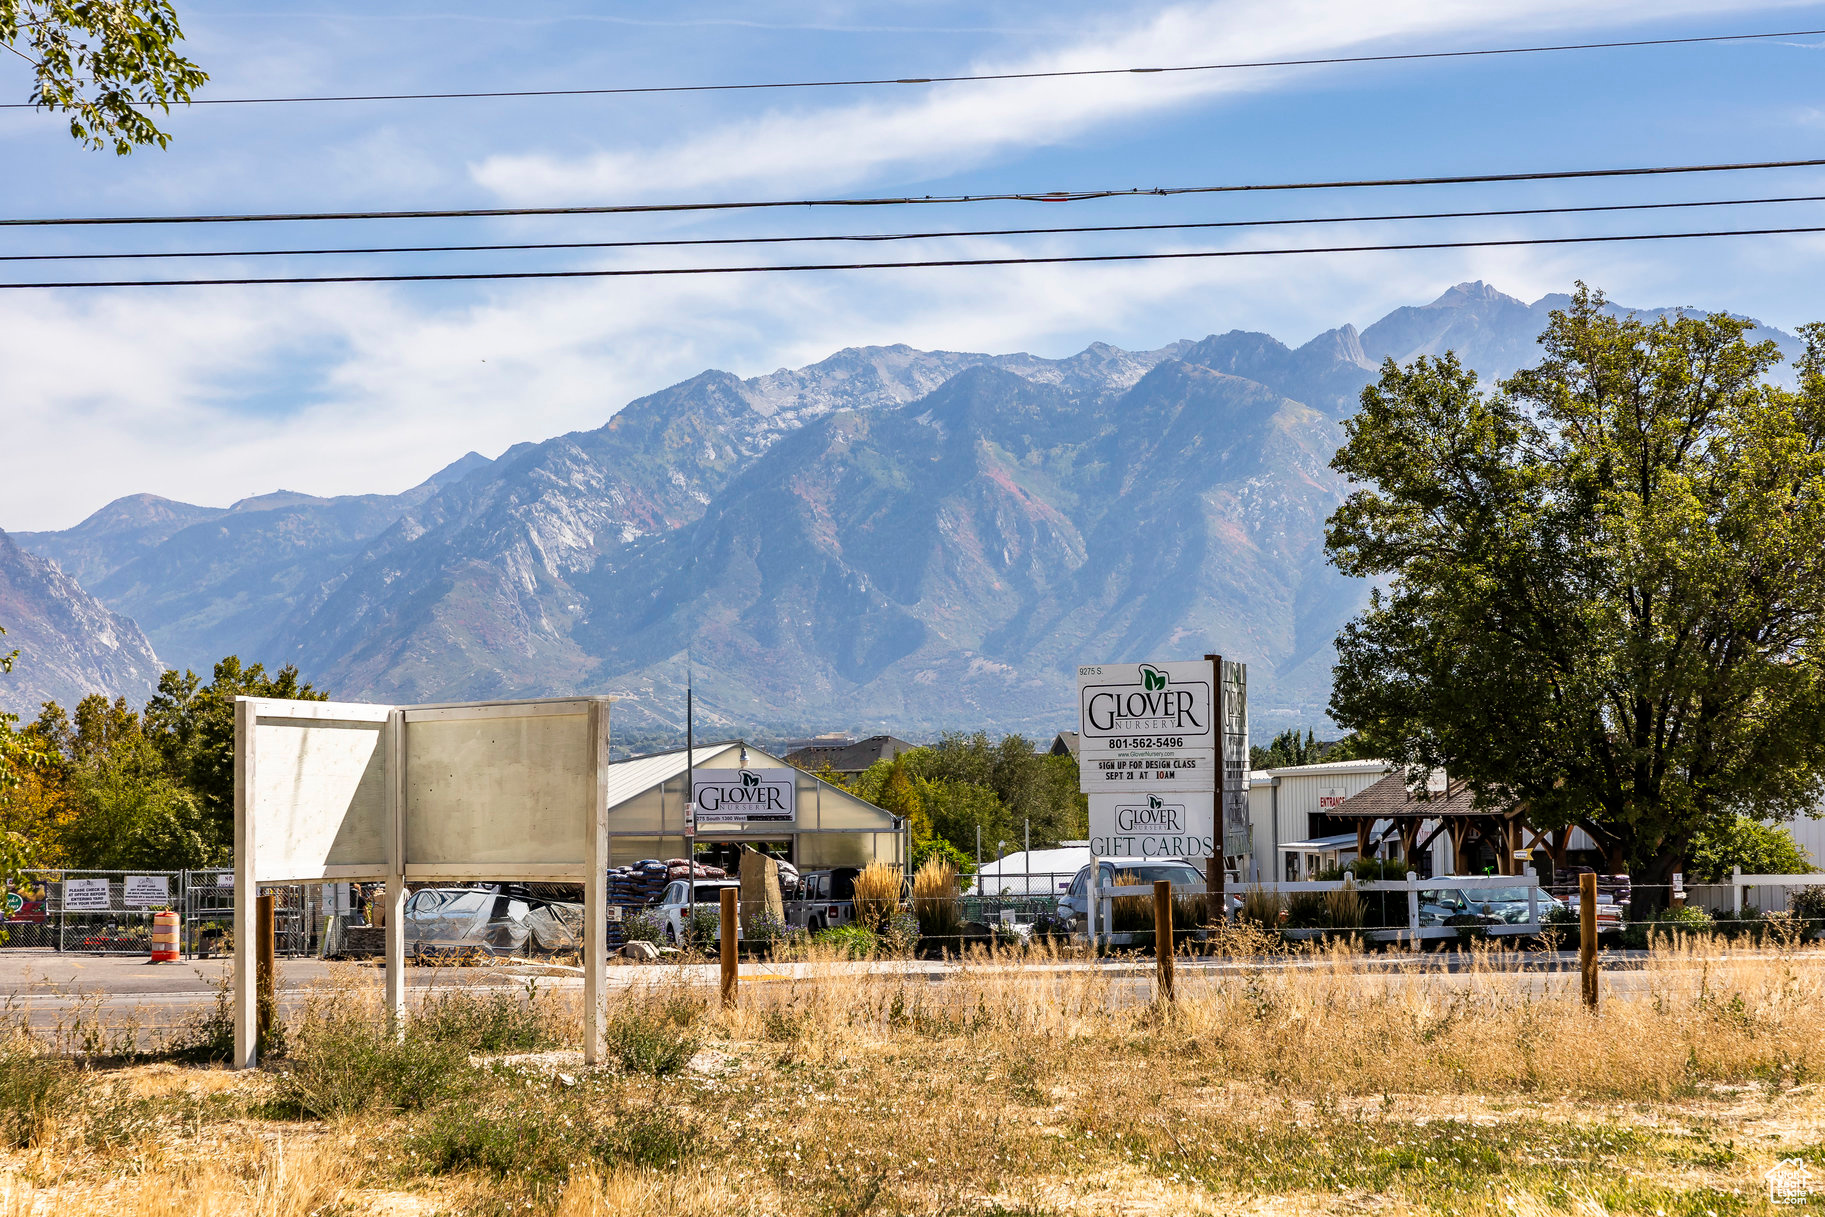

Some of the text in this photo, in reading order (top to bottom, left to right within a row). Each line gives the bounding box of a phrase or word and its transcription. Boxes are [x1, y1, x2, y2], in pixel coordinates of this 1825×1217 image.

[1080, 667, 1104, 675] 9275 S.
[1089, 690, 1203, 731] GLOVER
[1115, 720, 1176, 730] NURSERY
[1108, 737, 1184, 749] 801-562-5496
[1099, 760, 1196, 770] SIGN UP FOR DESIGN CLASS
[1105, 771, 1123, 780] SEPT
[1139, 771, 1149, 780] AT
[1156, 770, 1175, 780] 10AM
[698, 786, 787, 811] GLOVER
[1118, 809, 1181, 831] GLOVER
[1090, 836, 1136, 857] GIFT
[1142, 836, 1213, 857] CARDS
